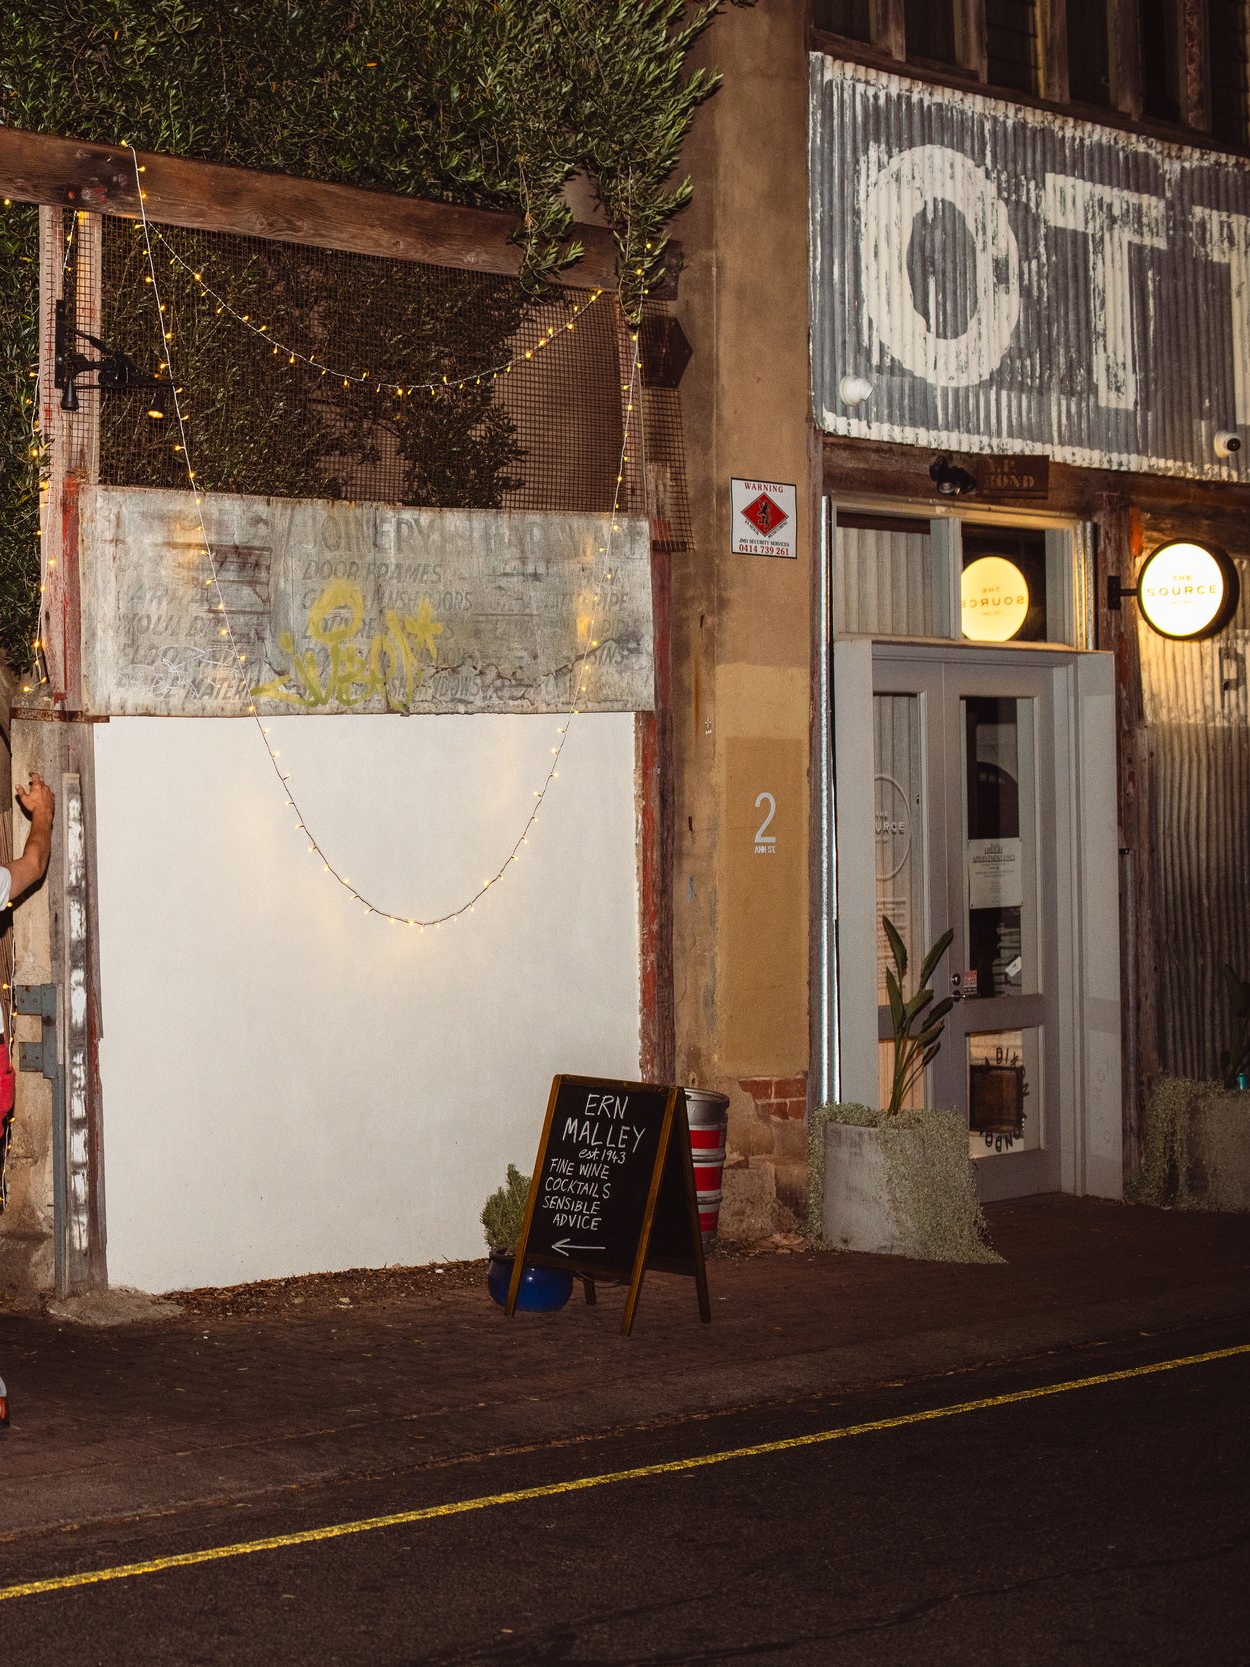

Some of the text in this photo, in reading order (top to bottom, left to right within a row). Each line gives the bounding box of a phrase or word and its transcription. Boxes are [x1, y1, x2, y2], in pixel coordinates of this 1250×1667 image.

[744, 482, 784, 493] WARNING
[739, 544, 789, 555] 0414 739 261
[1147, 585, 1217, 596] SOURCE
[755, 792, 776, 843] 2
[584, 1093, 629, 1119] ERN
[562, 1117, 645, 1153] MALLEY
[549, 1158, 610, 1180] FINE WINE
[545, 1177, 611, 1199] COCKTAILS
[542, 1195, 600, 1214] SENSIBLE
[553, 1214, 602, 1231] ADVICE
